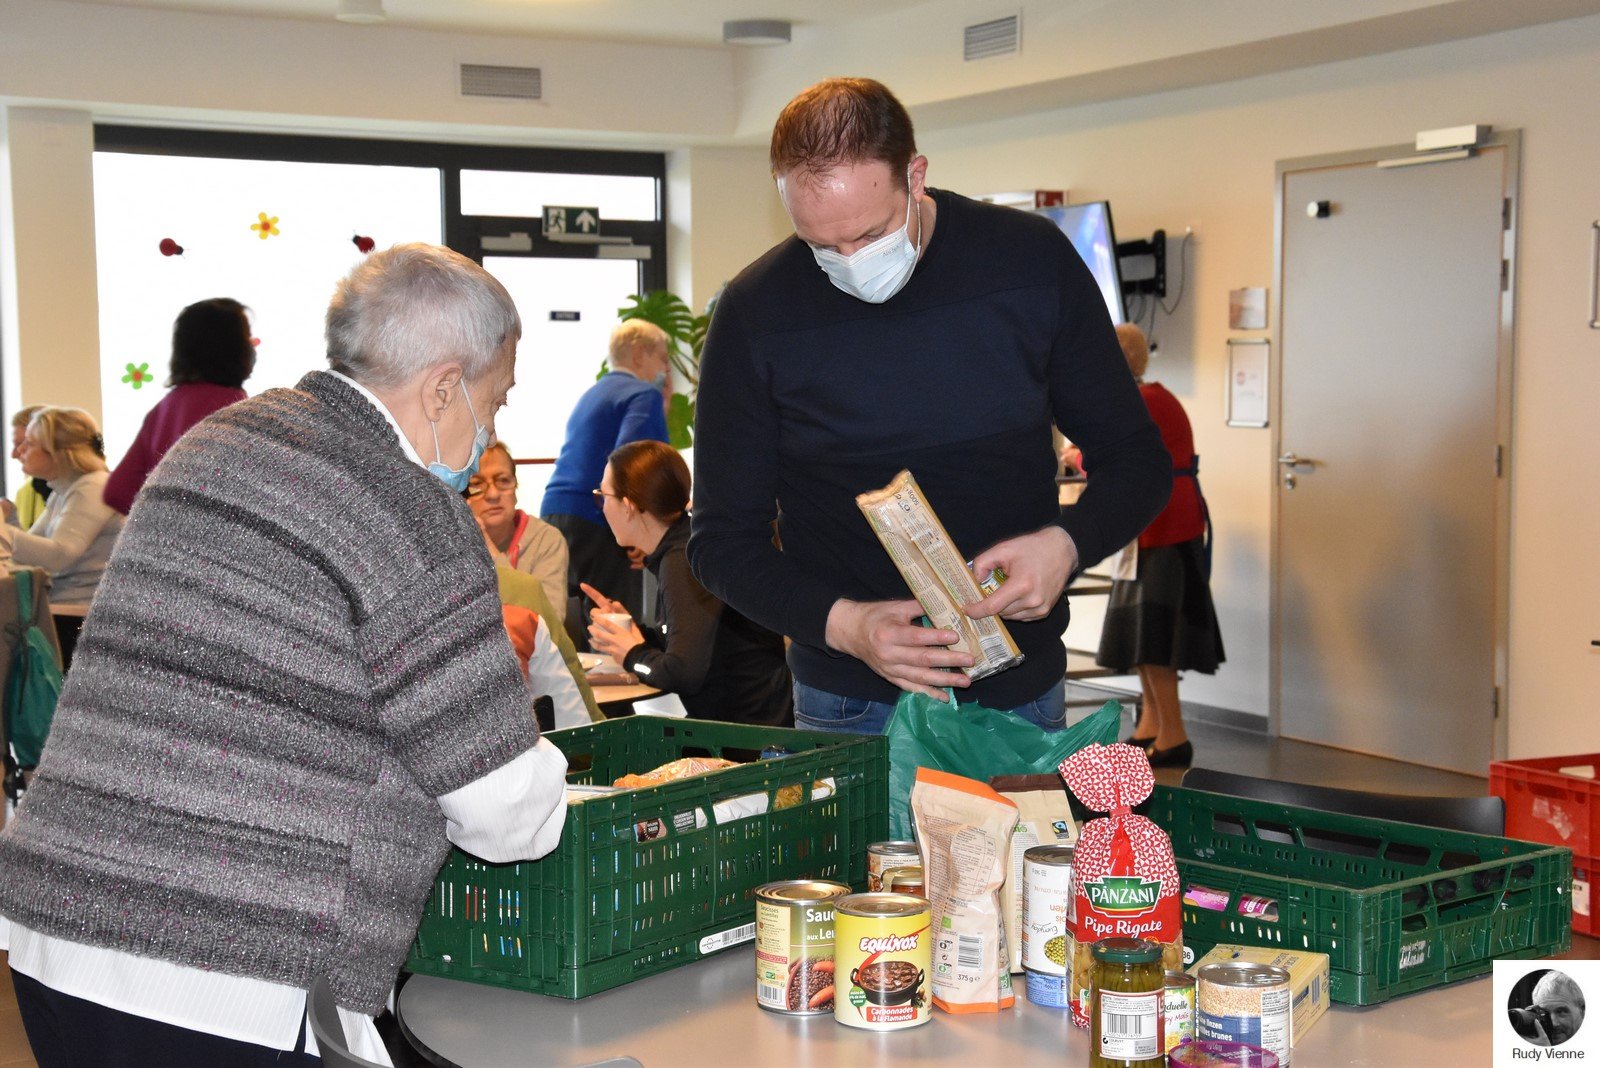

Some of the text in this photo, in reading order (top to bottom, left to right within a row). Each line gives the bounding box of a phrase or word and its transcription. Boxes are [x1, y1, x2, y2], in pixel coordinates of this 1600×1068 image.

[1084, 915, 1162, 939] Pipe Rigate
[871, 1007, 913, 1015] Carbonnades
[884, 1014, 913, 1022] Flamande
[1211, 1029, 1233, 1042] brunes
